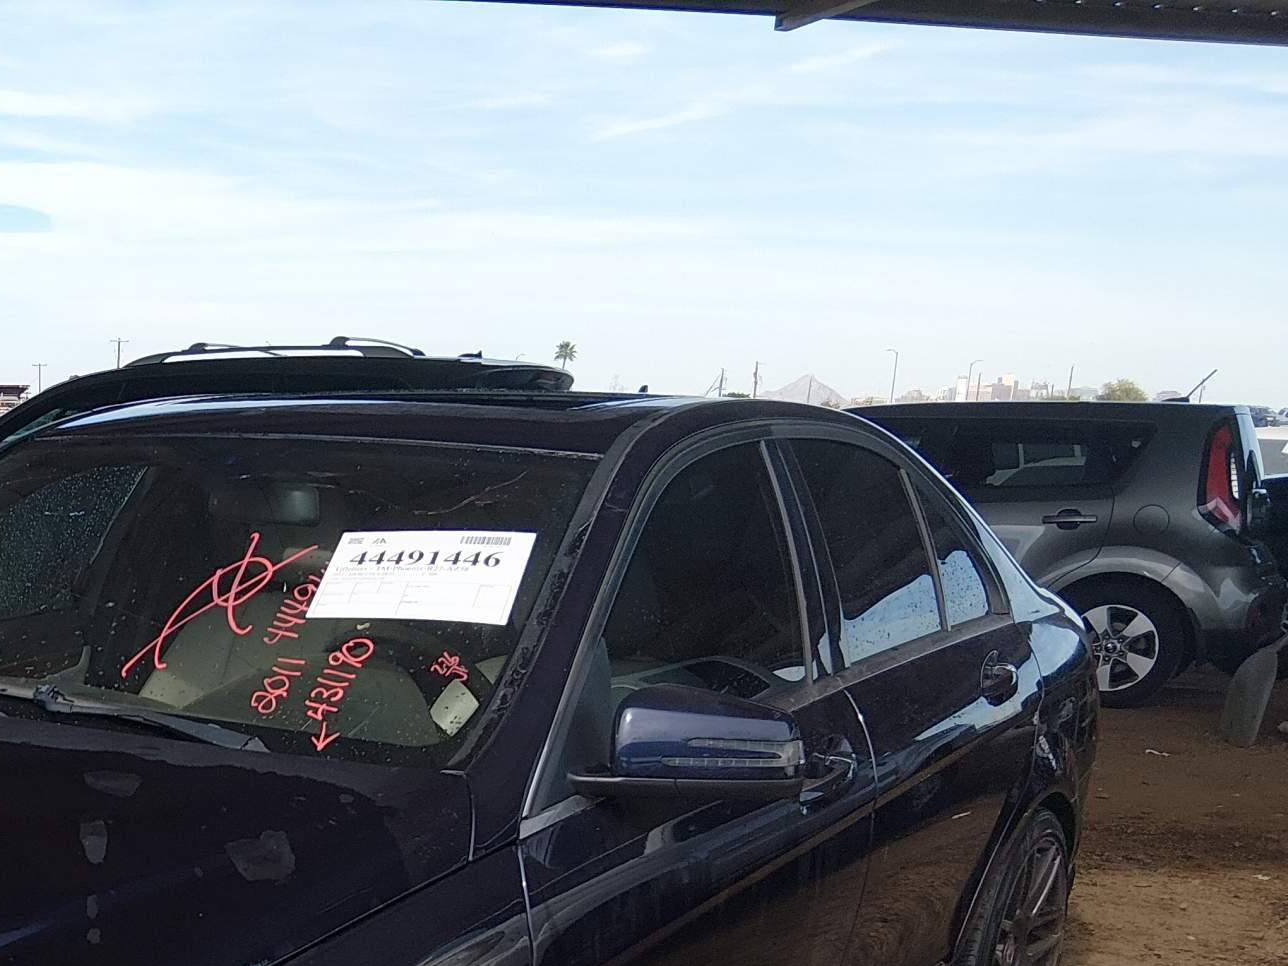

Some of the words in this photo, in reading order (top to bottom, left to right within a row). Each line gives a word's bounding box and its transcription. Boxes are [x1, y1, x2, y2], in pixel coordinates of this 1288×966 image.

[349, 549, 504, 568] 44491446
[251, 657, 306, 714] 2011
[304, 637, 375, 721] 431190
